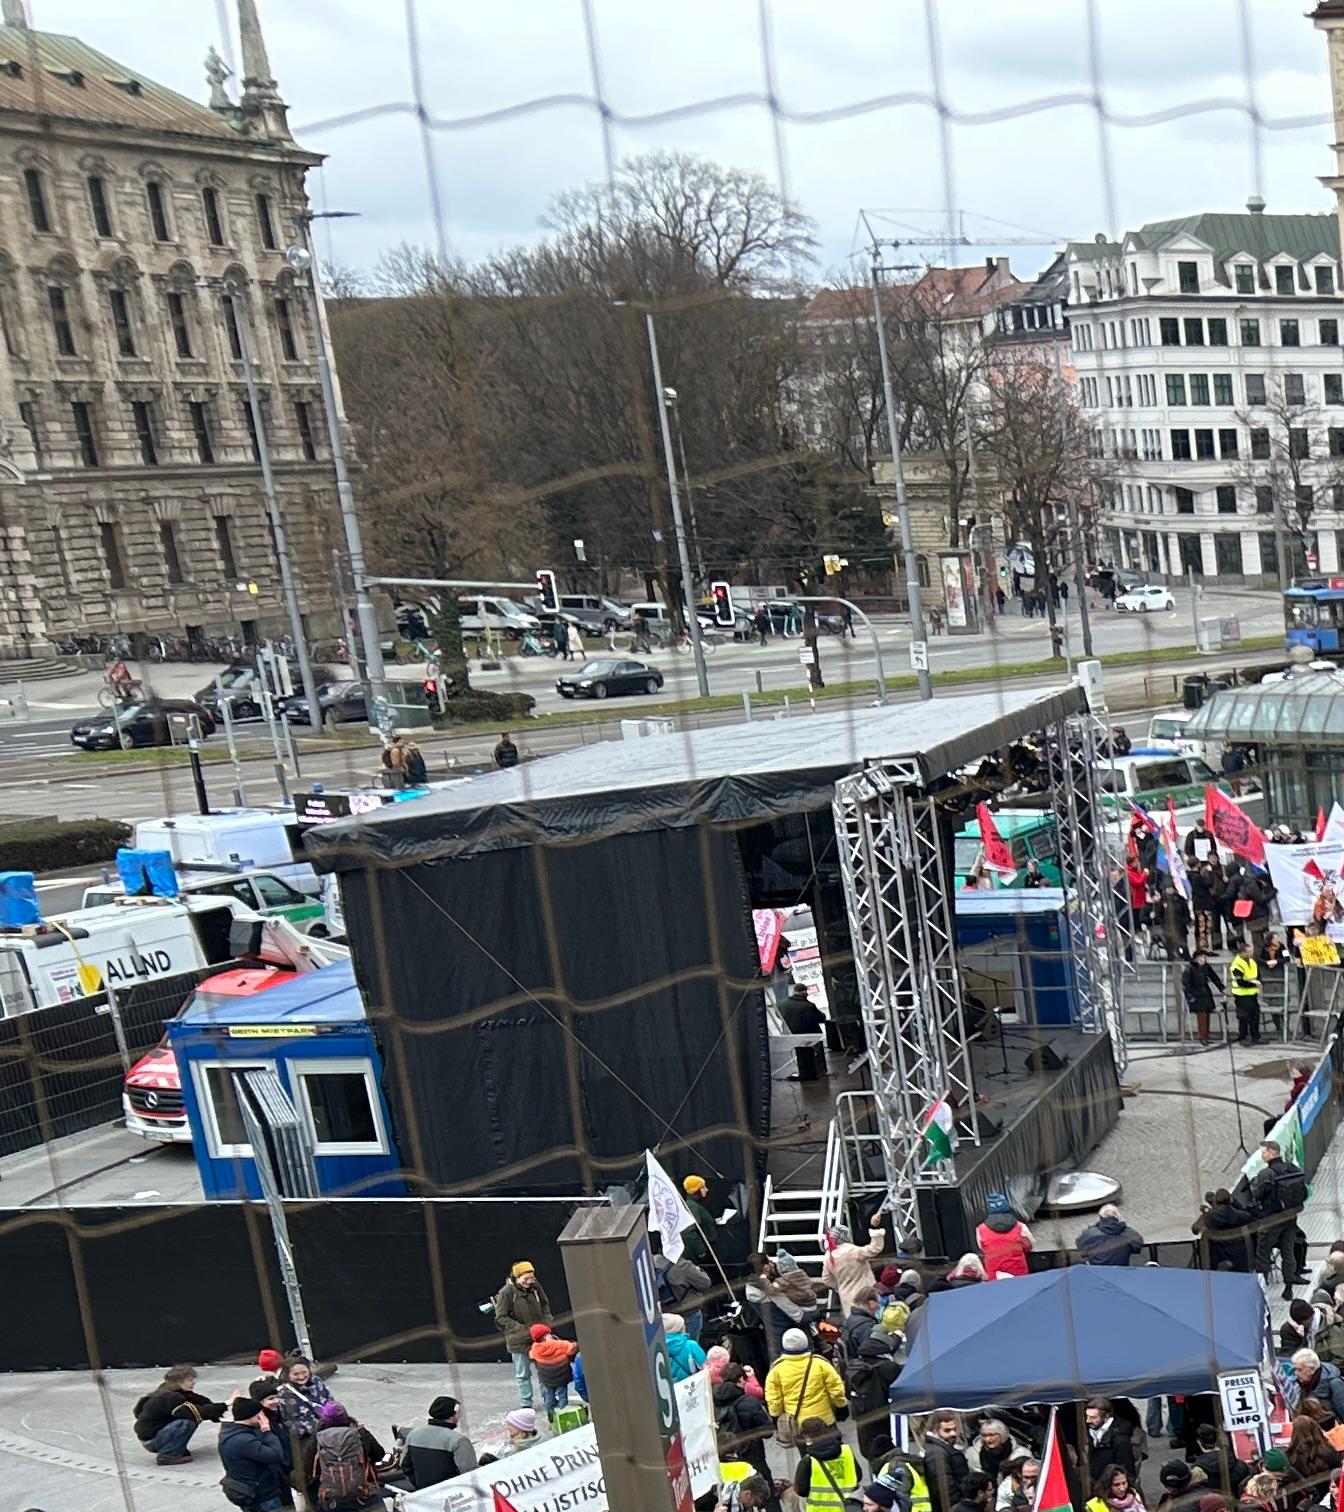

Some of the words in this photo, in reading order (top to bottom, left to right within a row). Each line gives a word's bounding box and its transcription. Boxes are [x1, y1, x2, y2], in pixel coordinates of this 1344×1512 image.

[655, 1349, 673, 1429] S
[1225, 1376, 1255, 1387] PRESSE
[1231, 1414, 1261, 1426] INFO
[492, 1466, 554, 1500] OHNE
